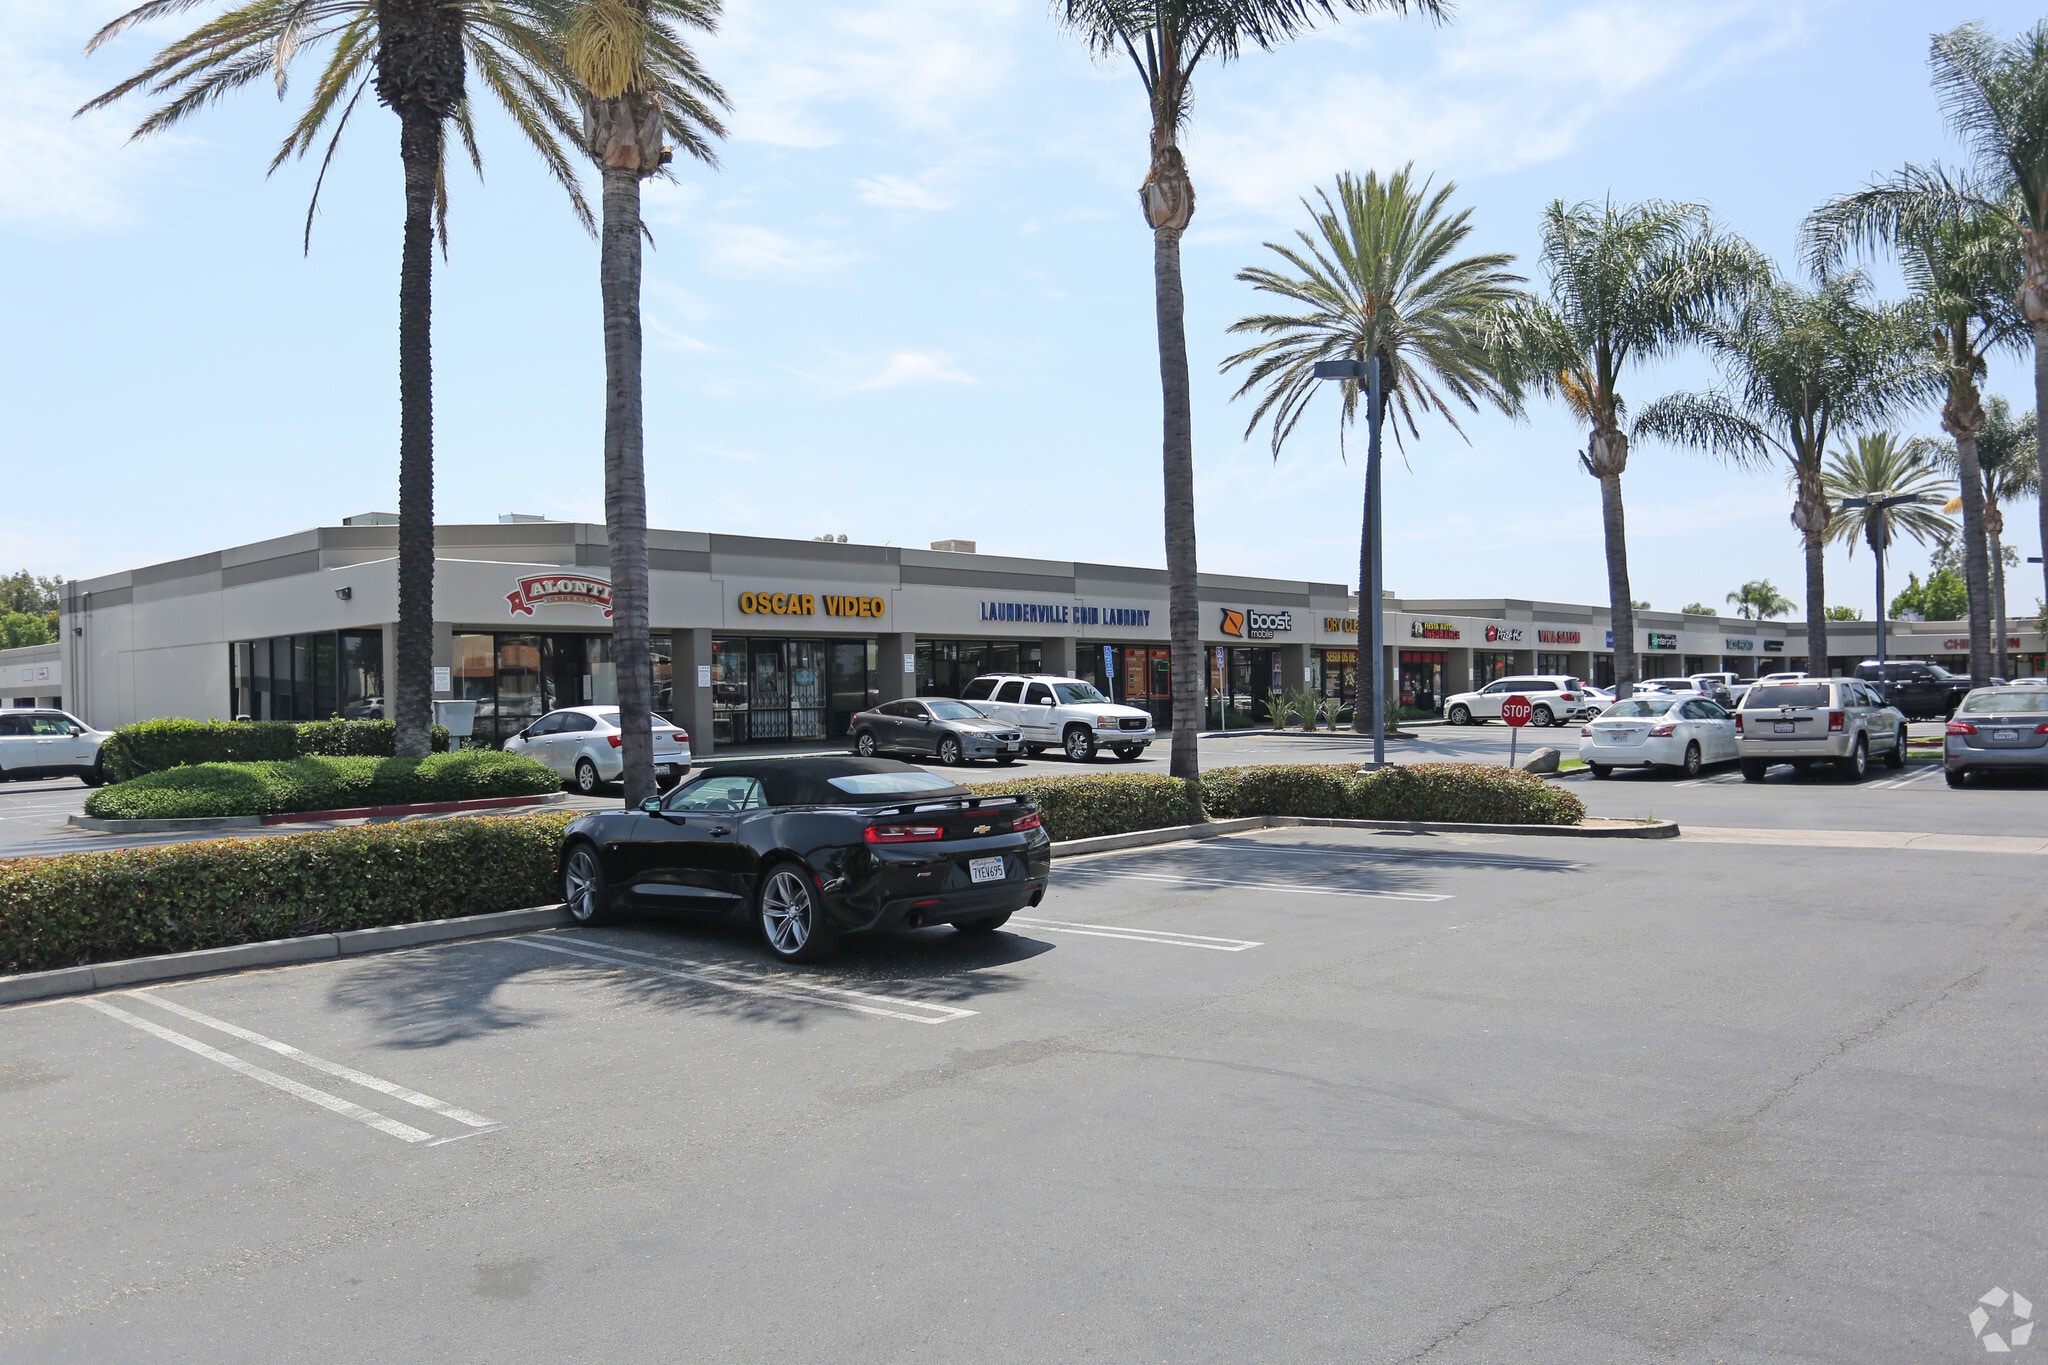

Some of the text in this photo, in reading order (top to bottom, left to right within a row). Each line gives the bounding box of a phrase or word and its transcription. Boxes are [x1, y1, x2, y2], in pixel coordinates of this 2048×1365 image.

[529, 579, 612, 599] ALONTI
[740, 591, 886, 618] OSCAR VIDEO
[980, 602, 1151, 627] LAUNDERVILLE COIN LAUNDRY
[1250, 611, 1291, 630] boost
[1326, 618, 1359, 632] DRY CLE
[1251, 630, 1274, 638] mobile
[1424, 630, 1460, 640] INSURANCE
[1539, 630, 1581, 644] VIVA SALON
[1503, 704, 1530, 718] STOP
[973, 865, 1003, 879] 7YEV695
